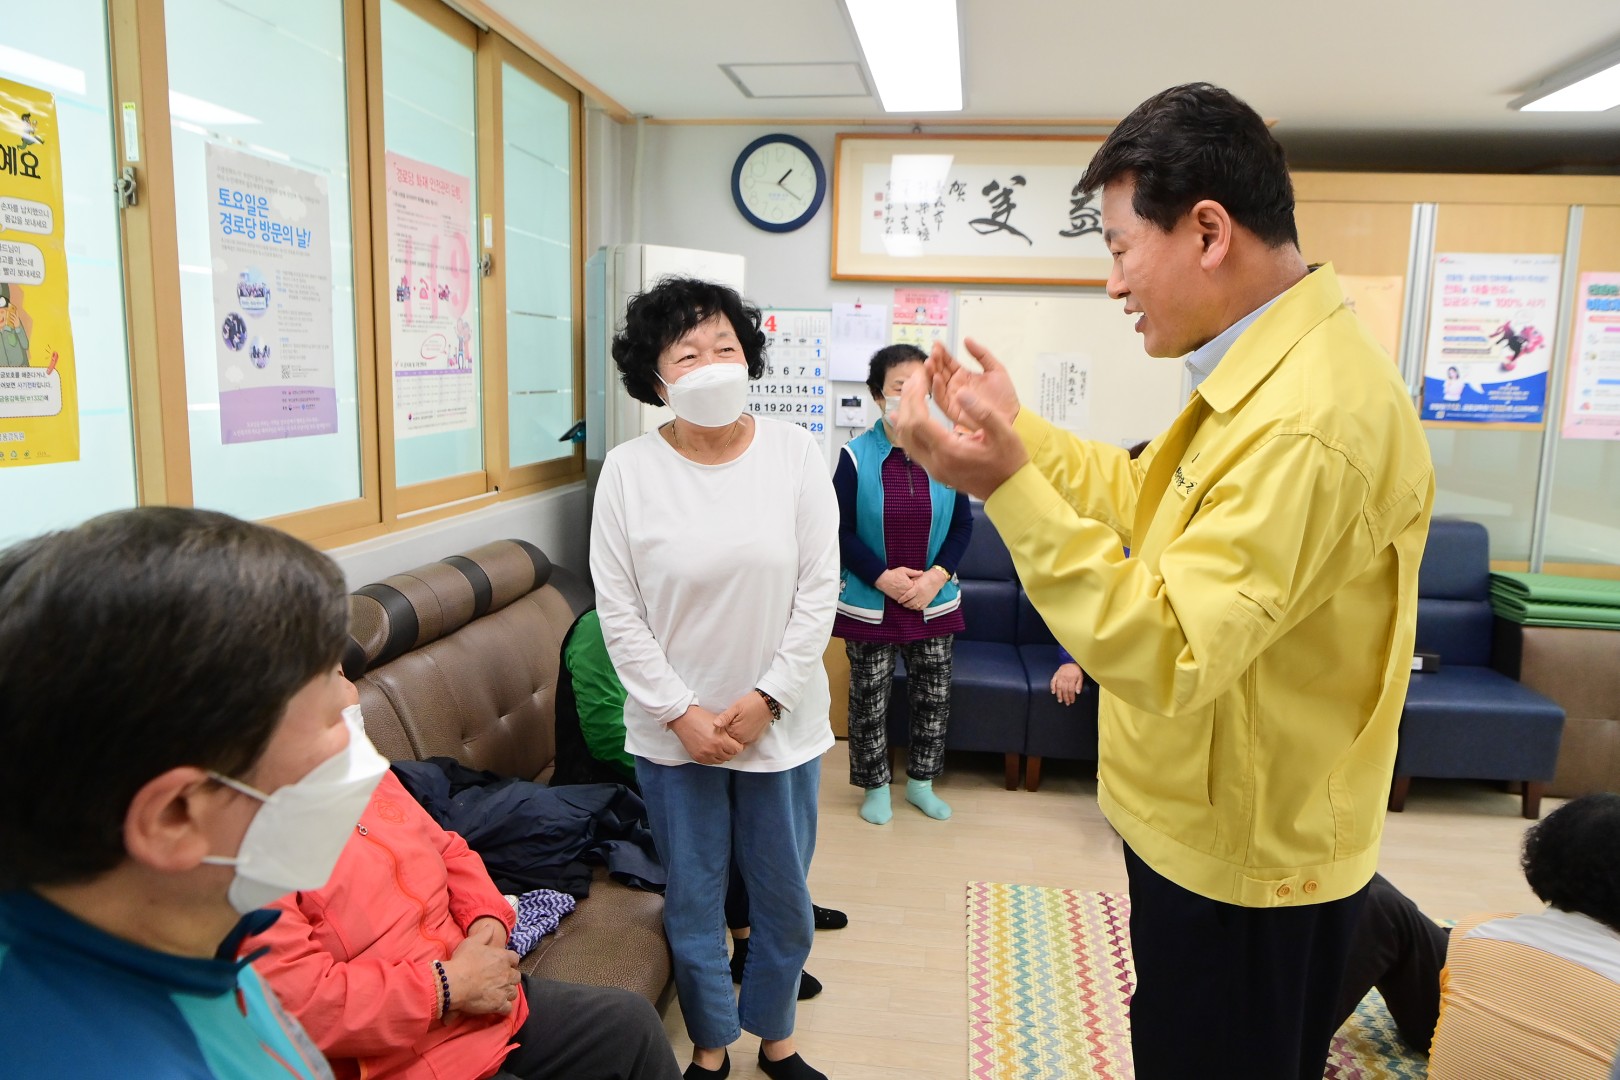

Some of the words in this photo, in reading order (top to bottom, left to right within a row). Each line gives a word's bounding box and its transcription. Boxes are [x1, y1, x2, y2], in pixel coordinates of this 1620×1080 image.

[218, 187, 270, 219] 토요일은
[219, 212, 257, 240] 경로당
[259, 219, 294, 246] 방문의
[295, 227, 311, 249] 날!
[764, 315, 777, 332] 4
[816, 349, 821, 357] 1
[768, 366, 774, 375] 5
[783, 366, 789, 375] 6
[799, 367, 806, 375] 7
[814, 367, 821, 377] 8
[749, 384, 761, 393] 11
[765, 385, 777, 394] 12
[780, 385, 792, 394] 13
[796, 385, 808, 394] 14
[811, 386, 824, 395] 15
[749, 403, 761, 412] 18
[764, 403, 777, 412] 19
[779, 403, 792, 412] 20
[795, 404, 808, 413] 21
[810, 404, 824, 414] 22
[810, 422, 824, 432] 29
